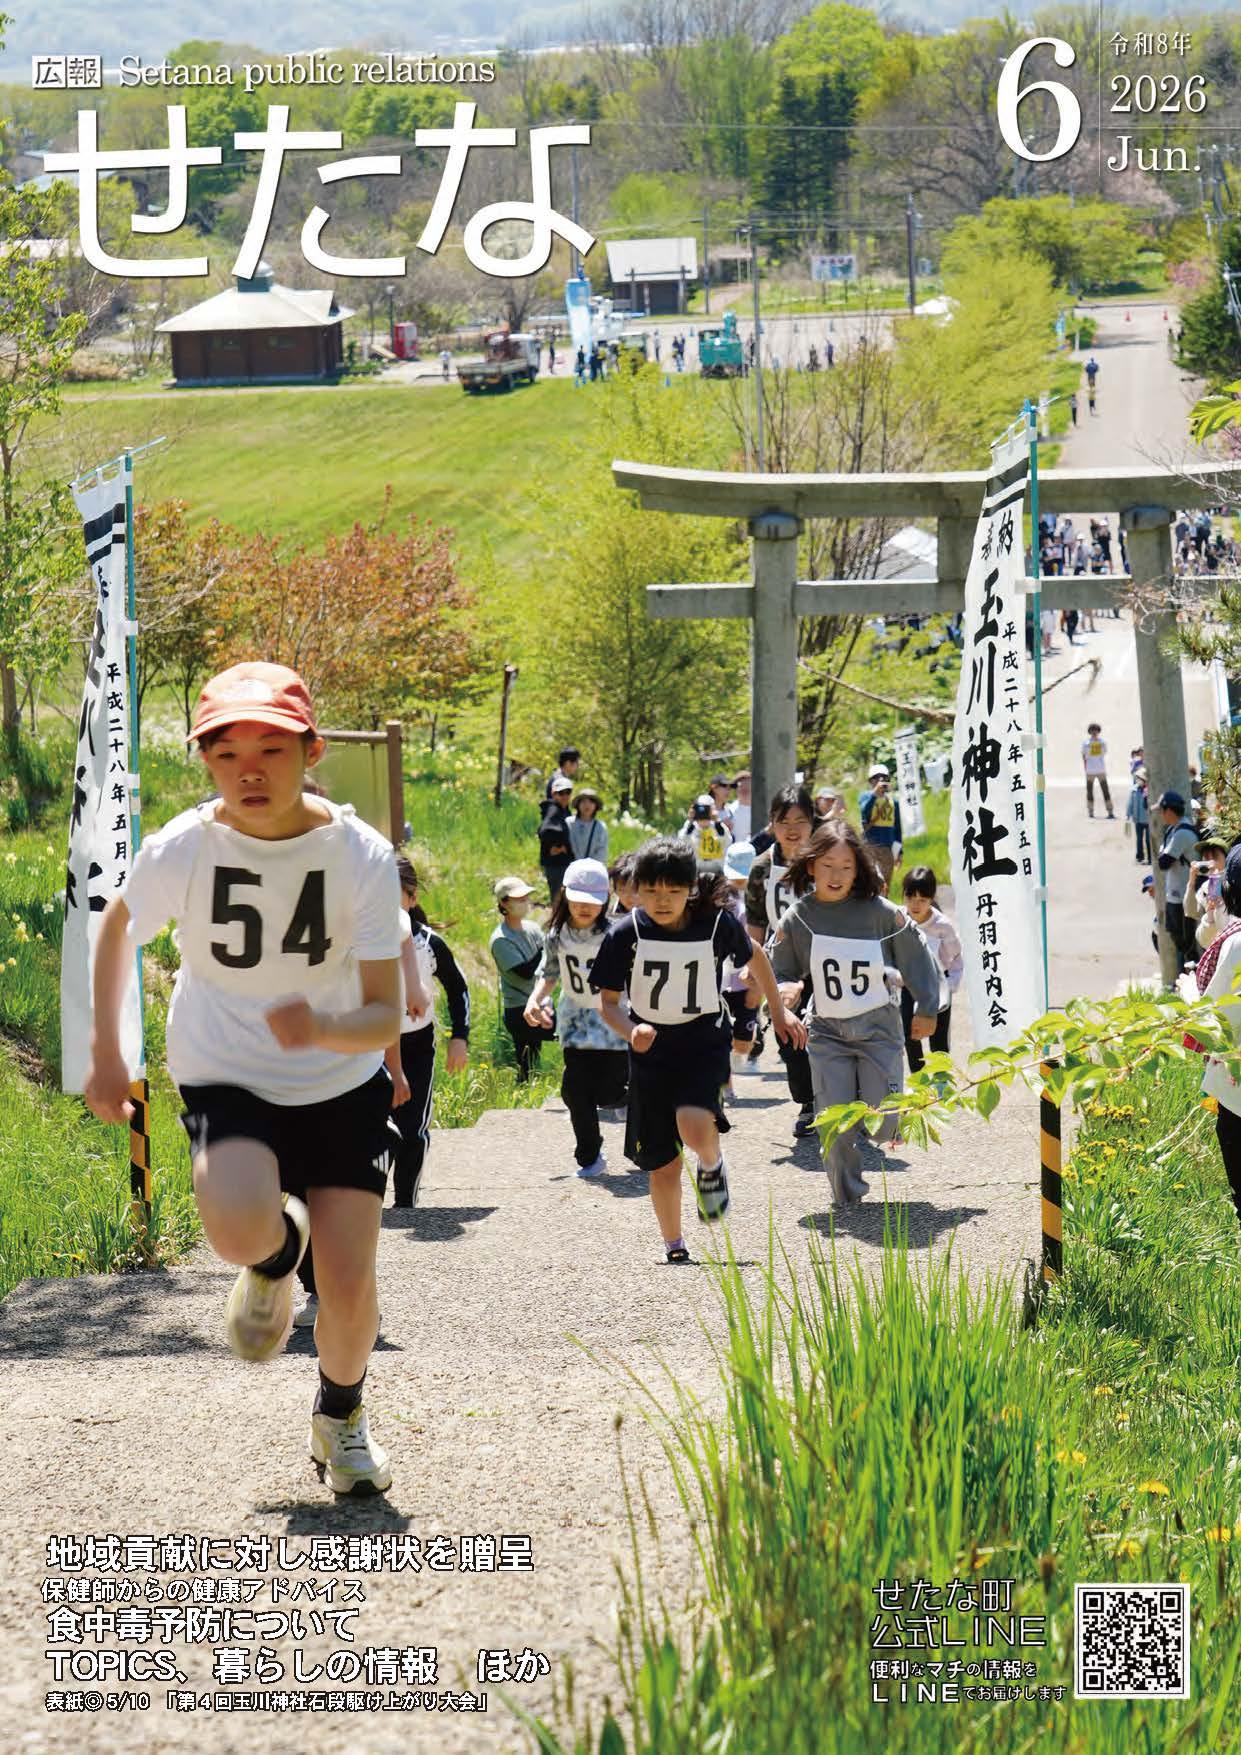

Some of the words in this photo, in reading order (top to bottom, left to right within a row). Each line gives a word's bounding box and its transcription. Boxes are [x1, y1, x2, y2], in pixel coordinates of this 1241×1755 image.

[961, 567, 1018, 886] 玉川神社
[1002, 621, 1033, 876] 平成二十八年五月五日
[210, 865, 332, 969] 54
[976, 893, 1008, 1028] 丹羽町内会
[643, 960, 702, 1014] 71
[823, 958, 870, 1001] 65
